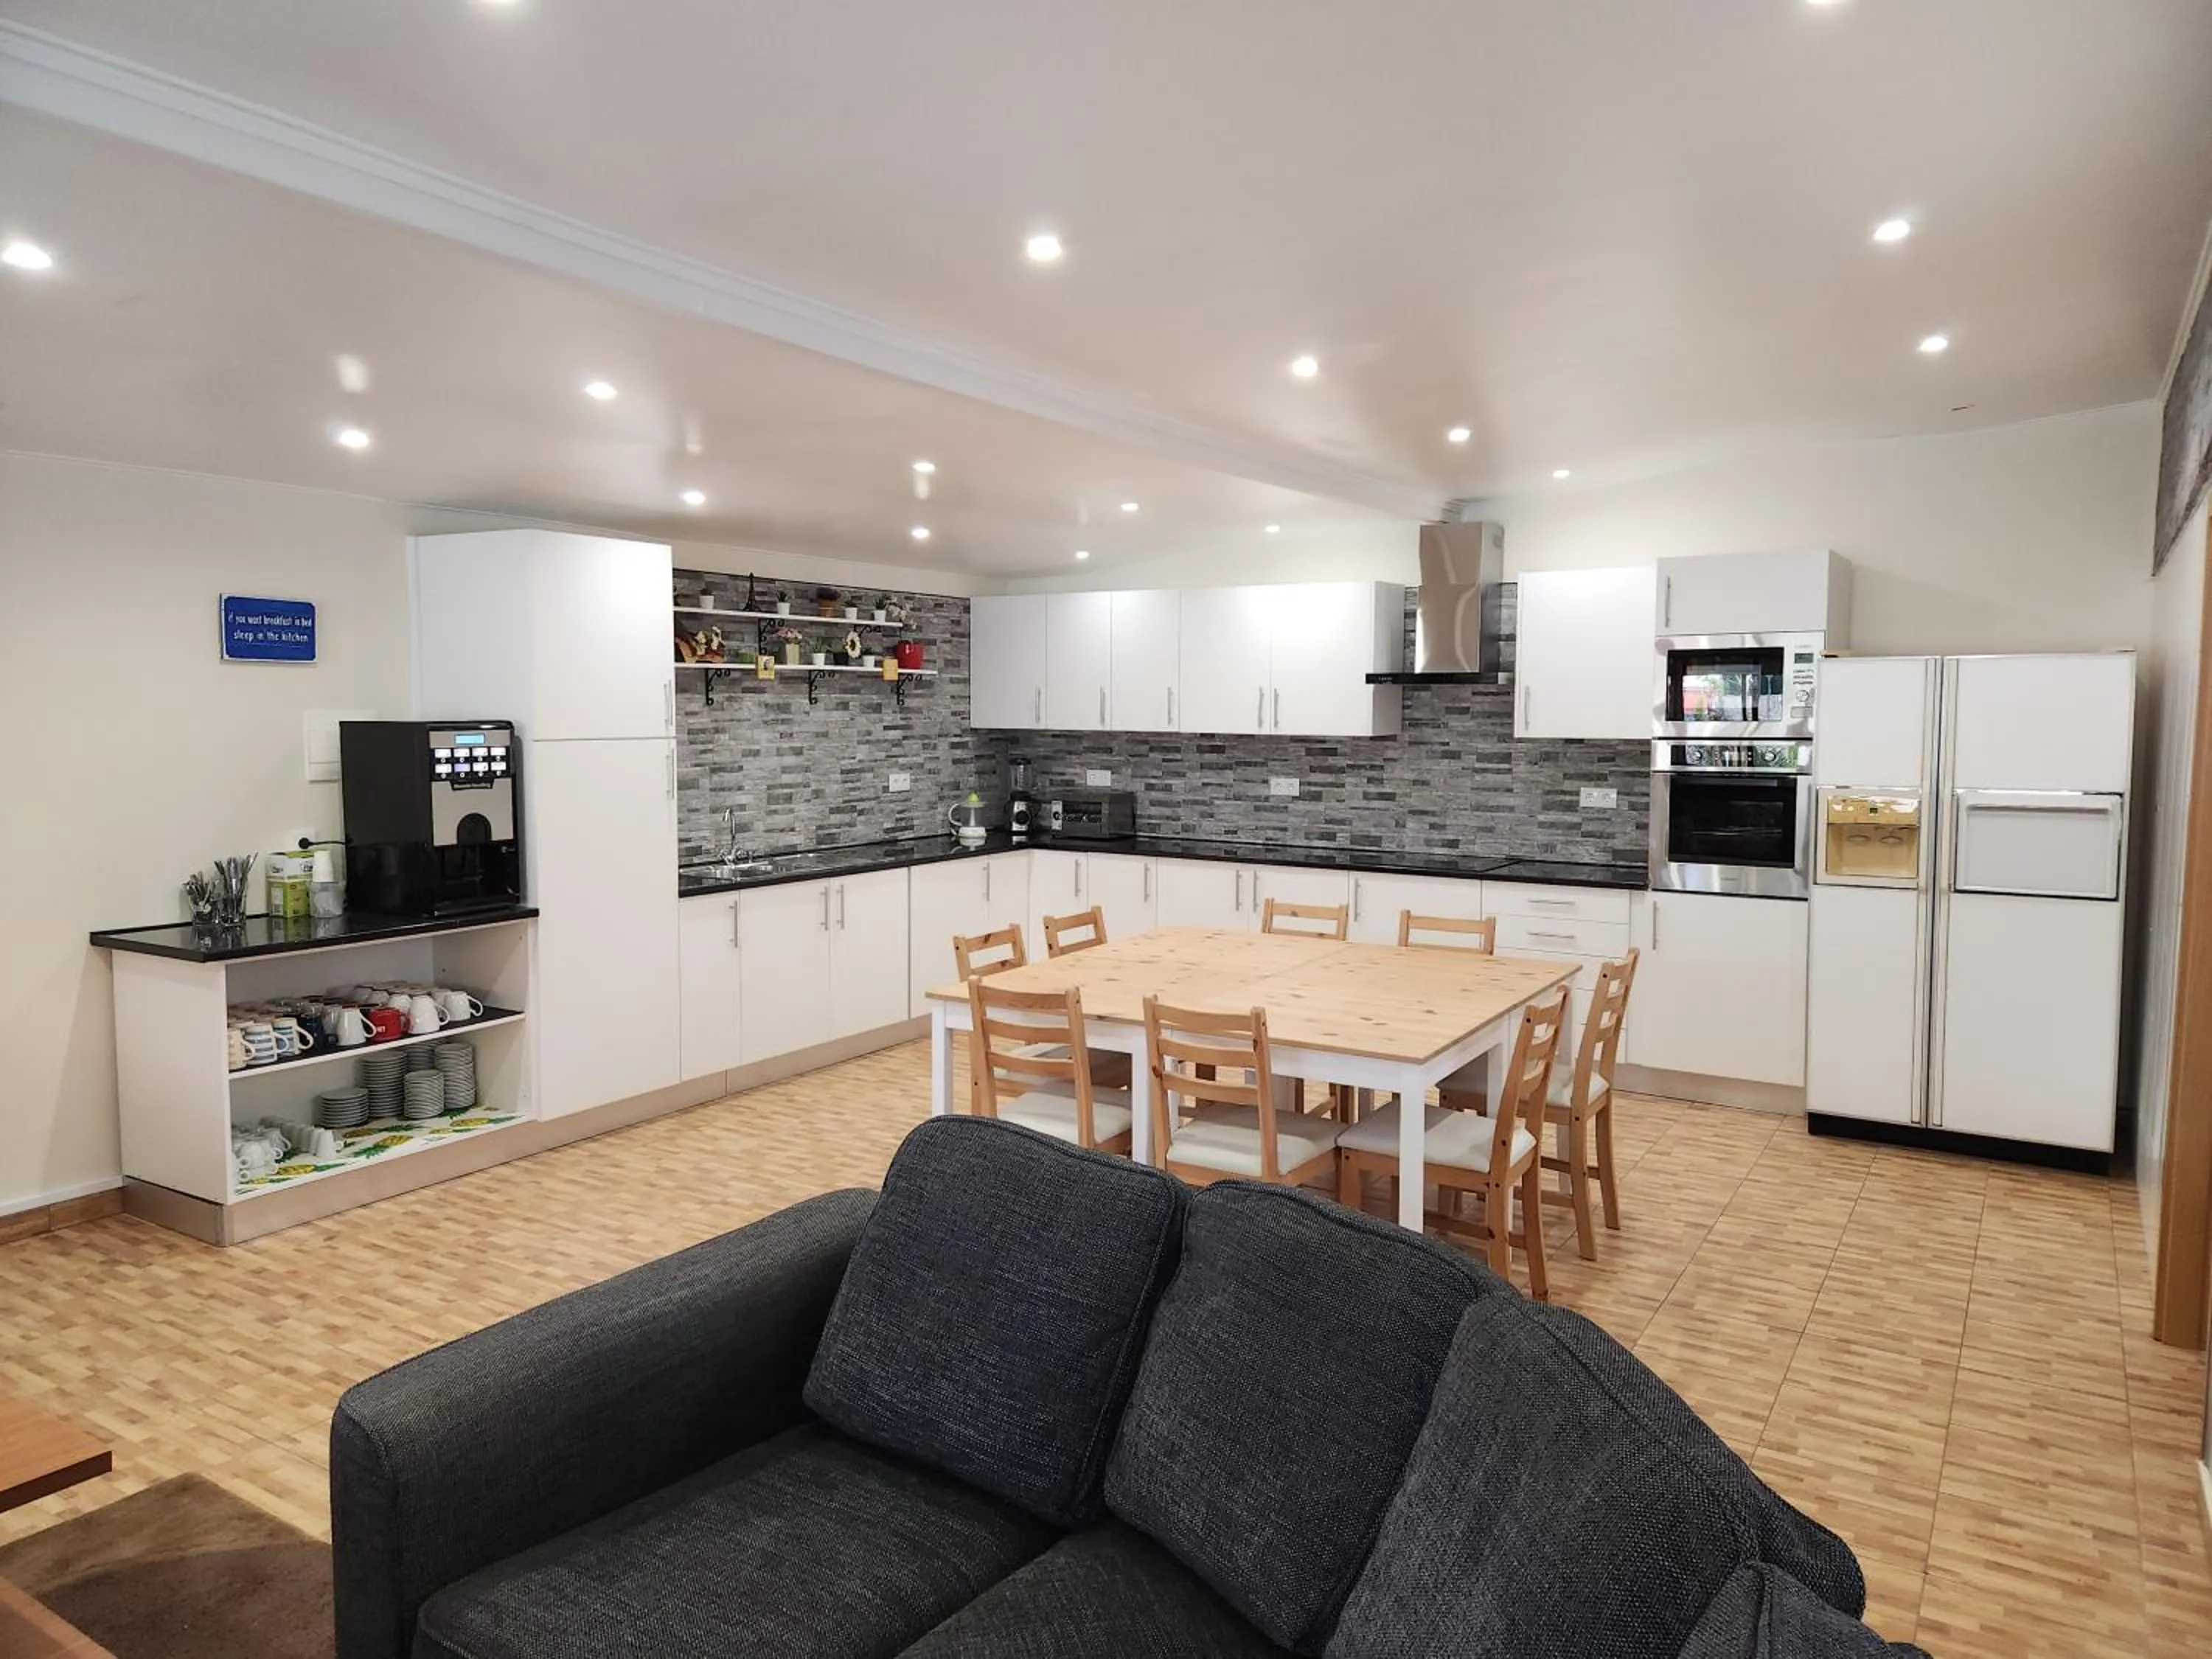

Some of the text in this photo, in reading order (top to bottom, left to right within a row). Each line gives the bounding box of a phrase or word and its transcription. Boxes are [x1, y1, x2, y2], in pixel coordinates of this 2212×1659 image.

[235, 615, 246, 625] you
[247, 615, 262, 625] want
[233, 630, 254, 643] sleep
[266, 631, 279, 641] the
[282, 631, 308, 643] kitchen
